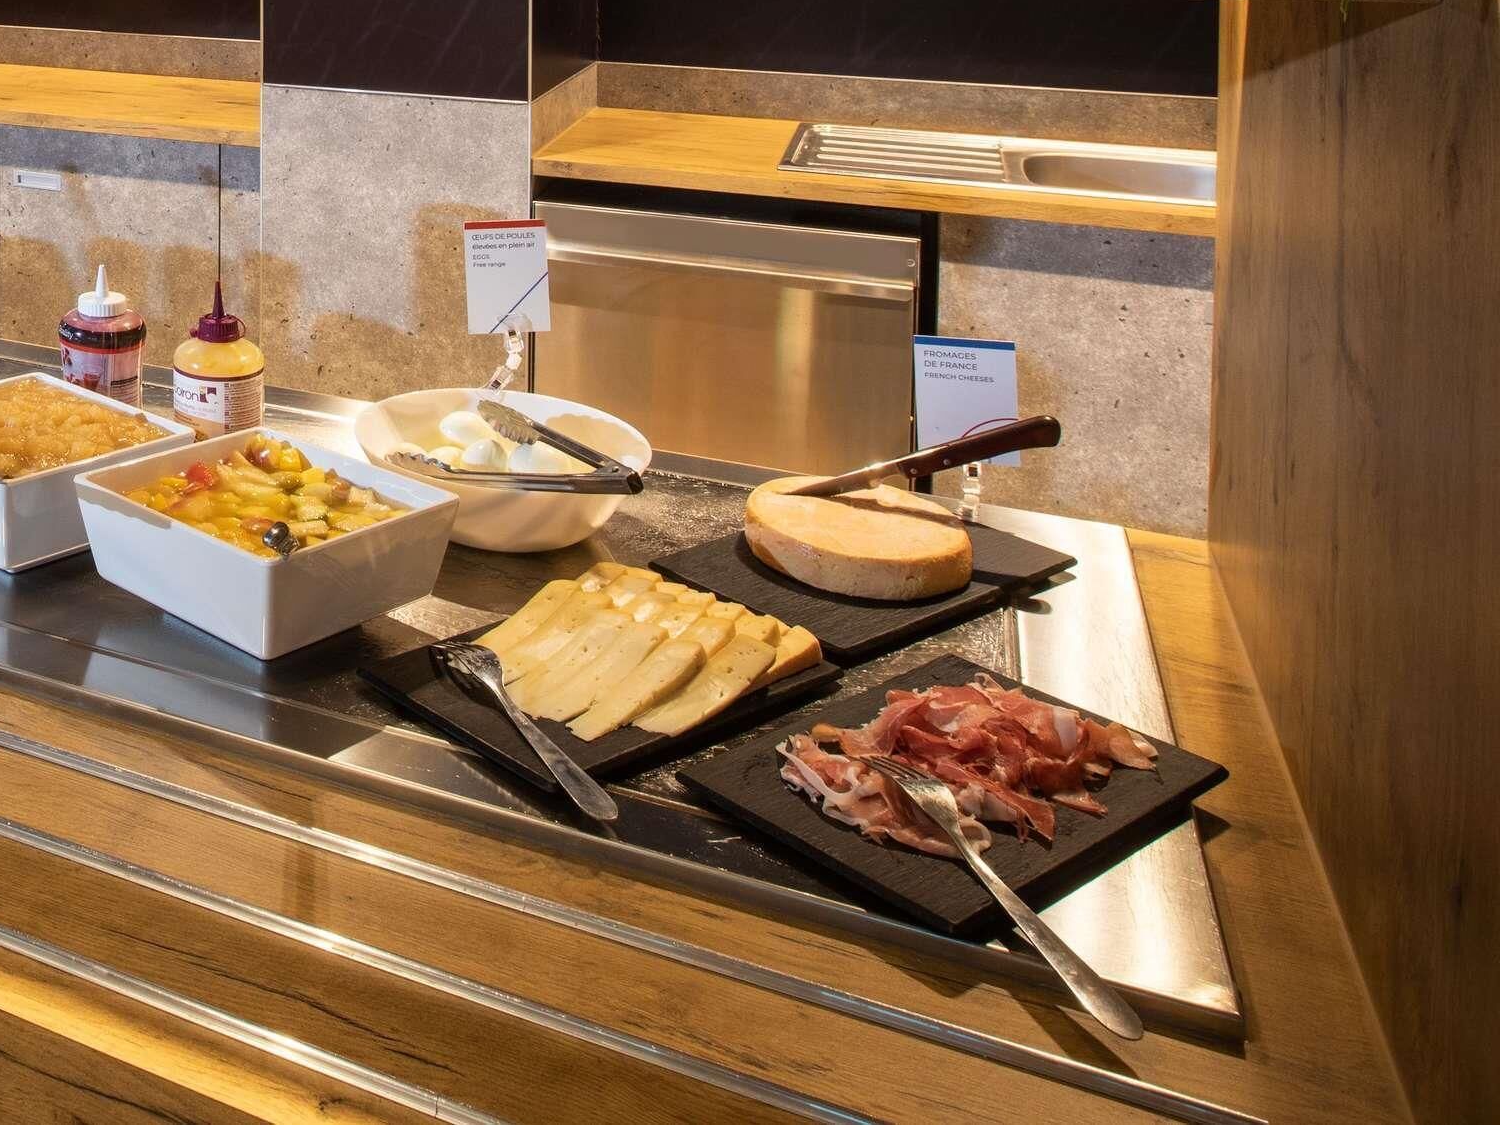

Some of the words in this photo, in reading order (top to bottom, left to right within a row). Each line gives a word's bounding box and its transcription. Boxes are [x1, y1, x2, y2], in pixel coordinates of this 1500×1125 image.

[506, 232, 536, 240] POULES
[508, 242, 525, 250] plein
[923, 350, 977, 361] FROMAGES
[924, 360, 938, 368] DE
[940, 361, 978, 371] FRANCE
[924, 372, 957, 380] FRENCH
[958, 374, 995, 383] CHEESES
